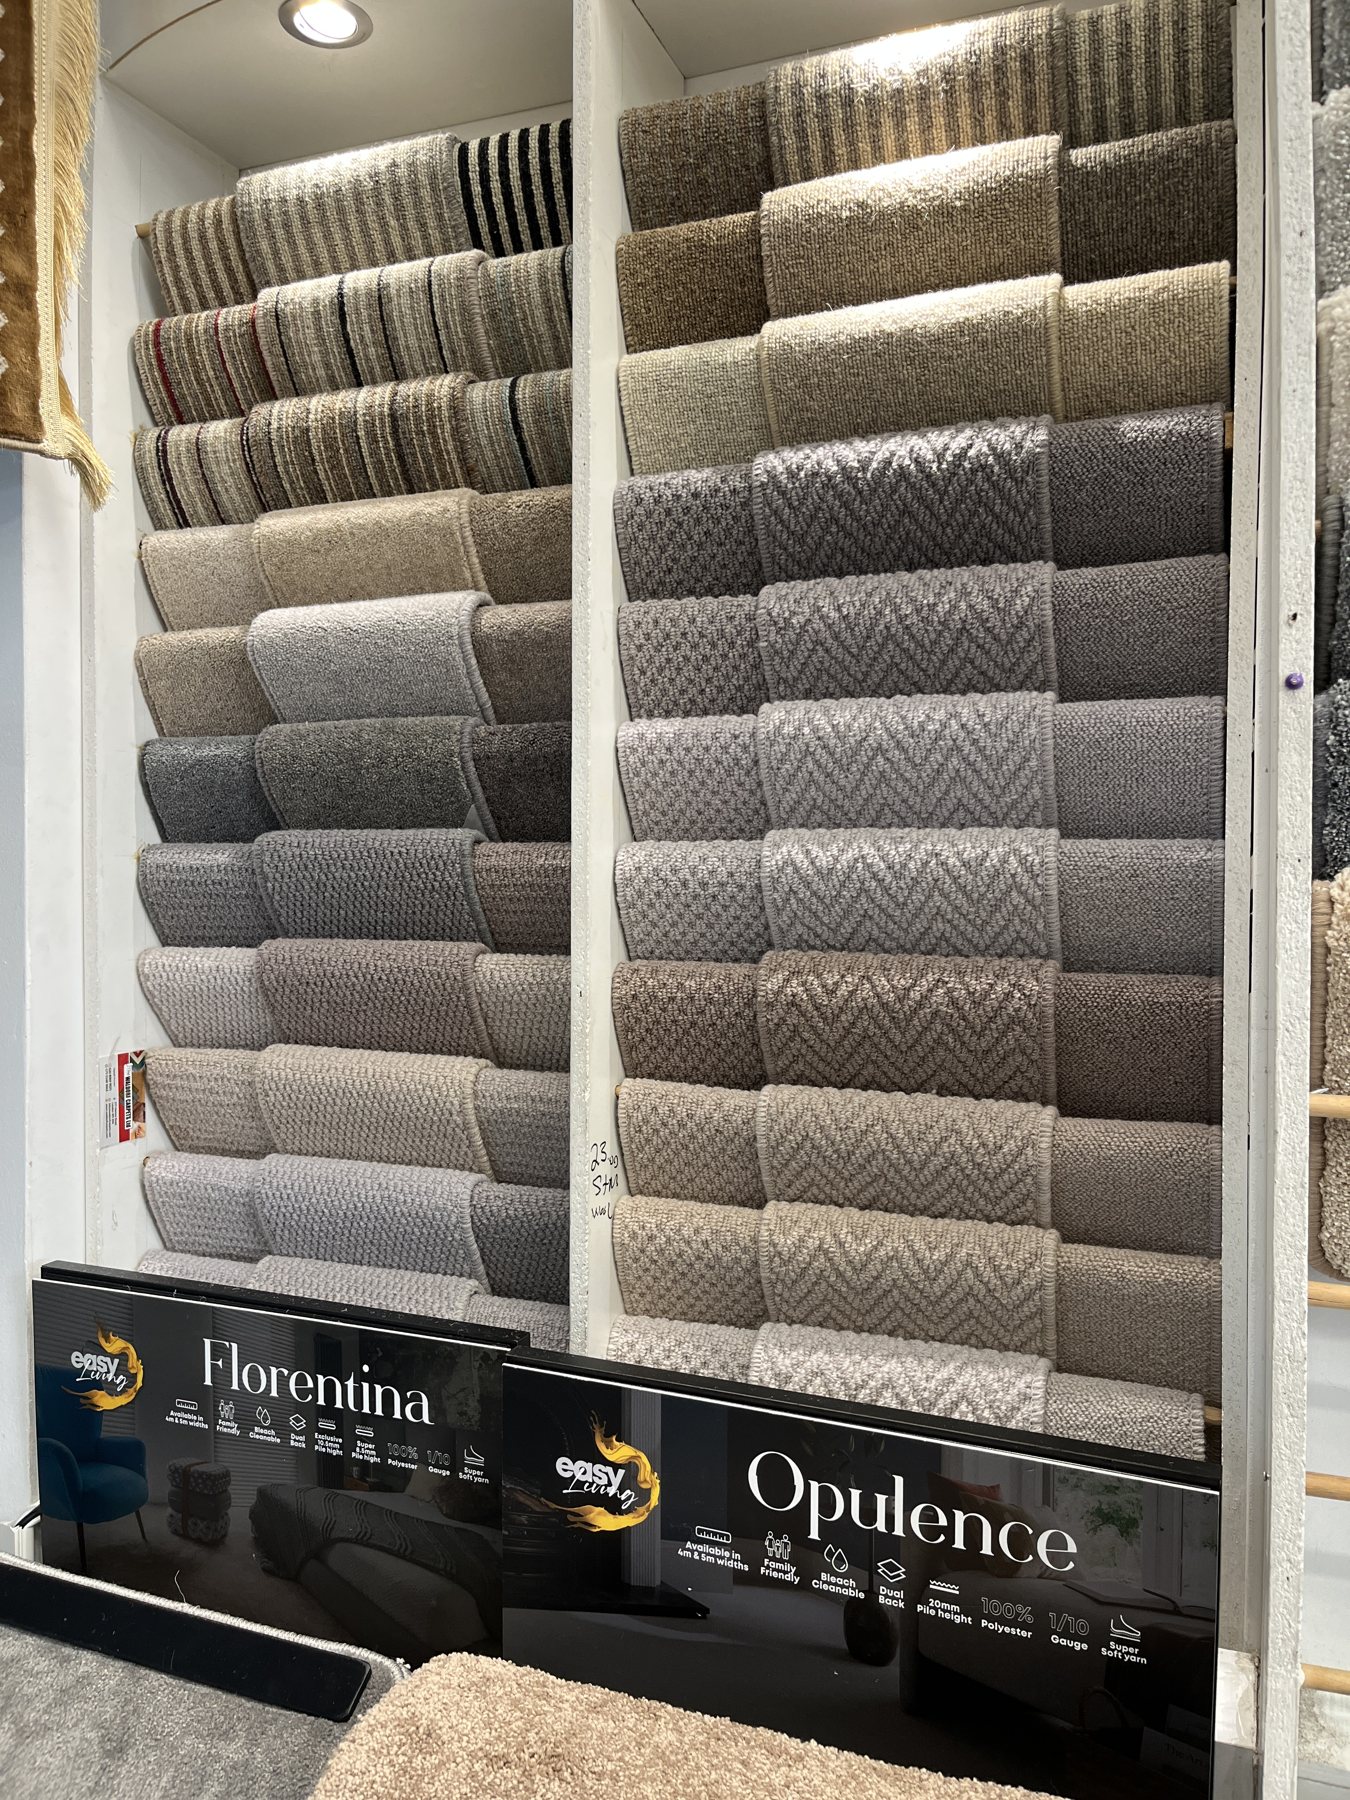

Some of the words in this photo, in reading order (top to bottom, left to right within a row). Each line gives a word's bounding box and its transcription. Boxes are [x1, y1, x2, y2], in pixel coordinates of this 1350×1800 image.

[71, 1351, 119, 1375] easy
[76, 1359, 128, 1391] Living
[202, 1337, 435, 1425] Florentina
[170, 1410, 197, 1420] Available
[189, 1420, 208, 1429] widths
[217, 1425, 240, 1436] Friendly
[218, 1419, 238, 1429] Family
[254, 1426, 275, 1436] Bleach
[249, 1432, 280, 1443] Cleanable
[290, 1433, 305, 1441] Dual
[290, 1440, 306, 1448] Back
[314, 1432, 342, 1443] Exclusive
[314, 1445, 326, 1453] Pile
[326, 1447, 343, 1456] hight
[317, 1440, 340, 1449] 10.5mm
[356, 1440, 375, 1450] Super
[387, 1442, 418, 1460] 100%
[351, 1452, 363, 1460] Pile
[364, 1453, 380, 1463] hight
[387, 1458, 418, 1470] Polyester
[427, 1450, 450, 1466] 1/10
[428, 1466, 450, 1476] Gauge
[458, 1472, 472, 1480] Soft
[473, 1476, 489, 1484] yarn
[464, 1467, 484, 1477] Super
[555, 1456, 626, 1488] easy
[562, 1466, 639, 1508] Living
[747, 1451, 1078, 1572] Opulence
[685, 1541, 730, 1558] Available
[731, 1550, 741, 1560] in
[677, 1548, 692, 1558] 4m
[693, 1551, 700, 1560] &
[701, 1553, 715, 1564] 5m
[716, 1556, 749, 1571] widths
[764, 1558, 797, 1573] Family
[760, 1567, 800, 1585] Friendly
[820, 1572, 856, 1588] Bleach
[811, 1579, 865, 1599] Cleanable
[879, 1585, 904, 1598] Dual
[878, 1595, 905, 1609] Back
[928, 1598, 960, 1612] 20mm
[917, 1604, 936, 1616] Pile
[937, 1608, 972, 1625] height
[981, 1597, 1034, 1624] 100%
[981, 1619, 1032, 1639] Polyester
[1049, 1612, 1090, 1636] 1/10
[1050, 1634, 1089, 1651] Gauge
[1109, 1641, 1139, 1655] Super
[1101, 1647, 1122, 1660] Soft
[1123, 1653, 1147, 1665] yarn
